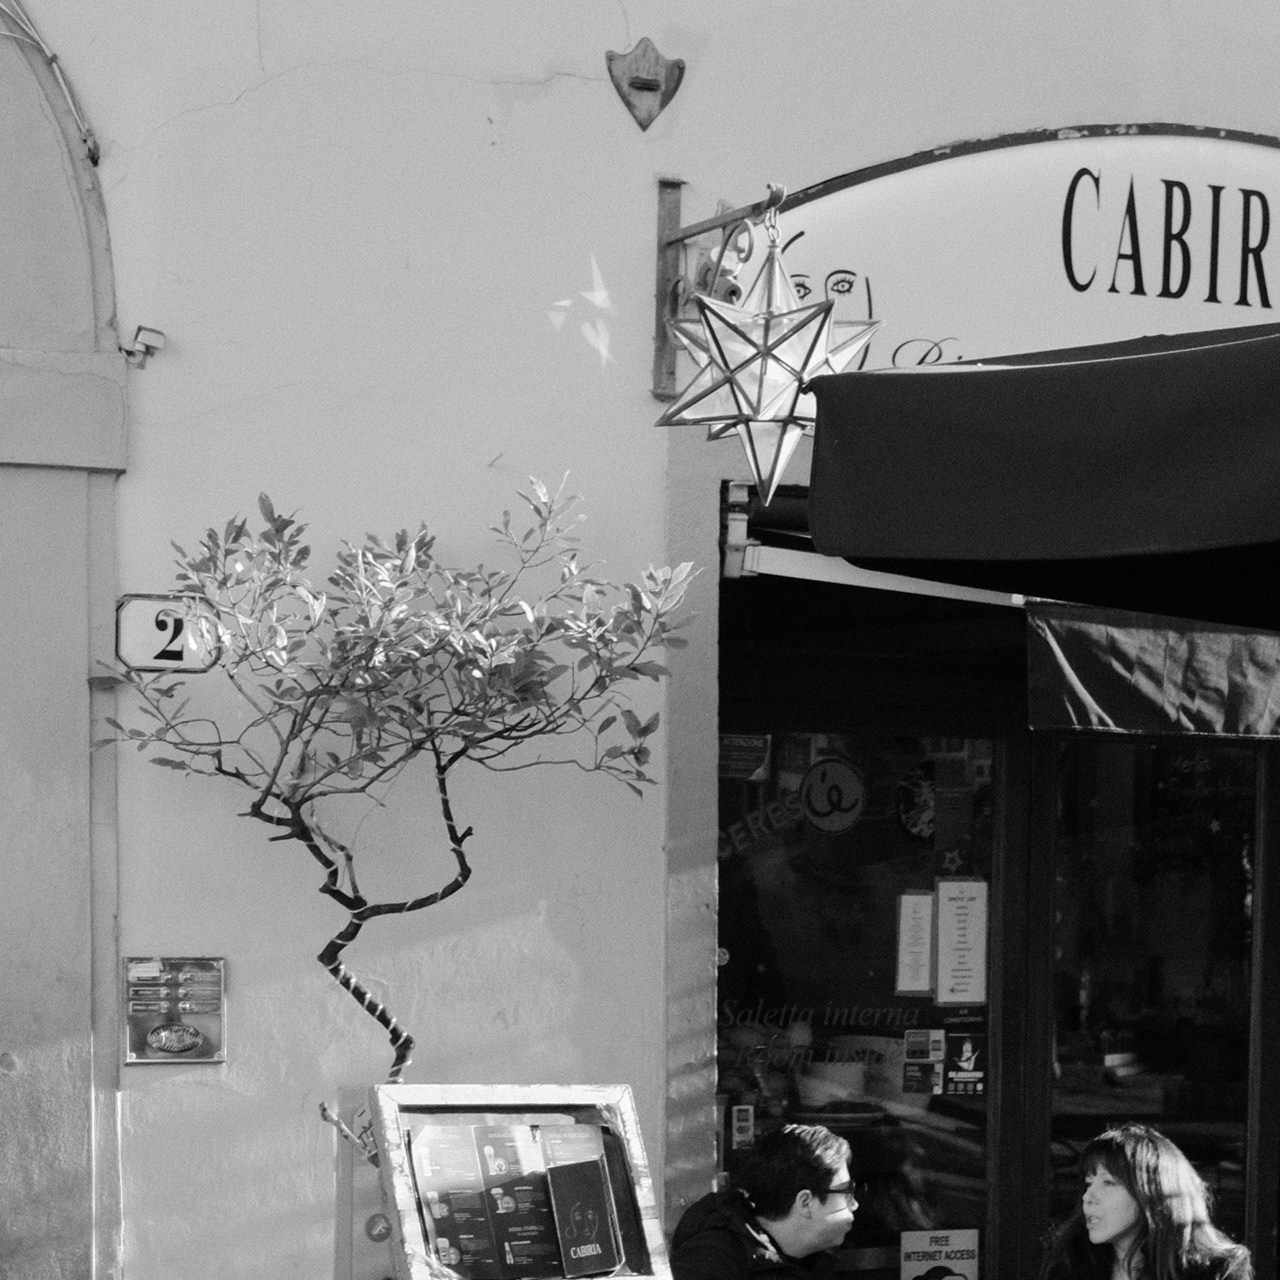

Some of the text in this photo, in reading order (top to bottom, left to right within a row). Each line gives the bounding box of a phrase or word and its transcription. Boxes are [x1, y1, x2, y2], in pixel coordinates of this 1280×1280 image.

[153, 608, 184, 661] 2
[721, 998, 920, 1027] Saletta interna
[929, 1236, 950, 1246] FREE
[570, 1242, 602, 1260] CABIRIA
[903, 1248, 976, 1262] INTERNET ACCESS
